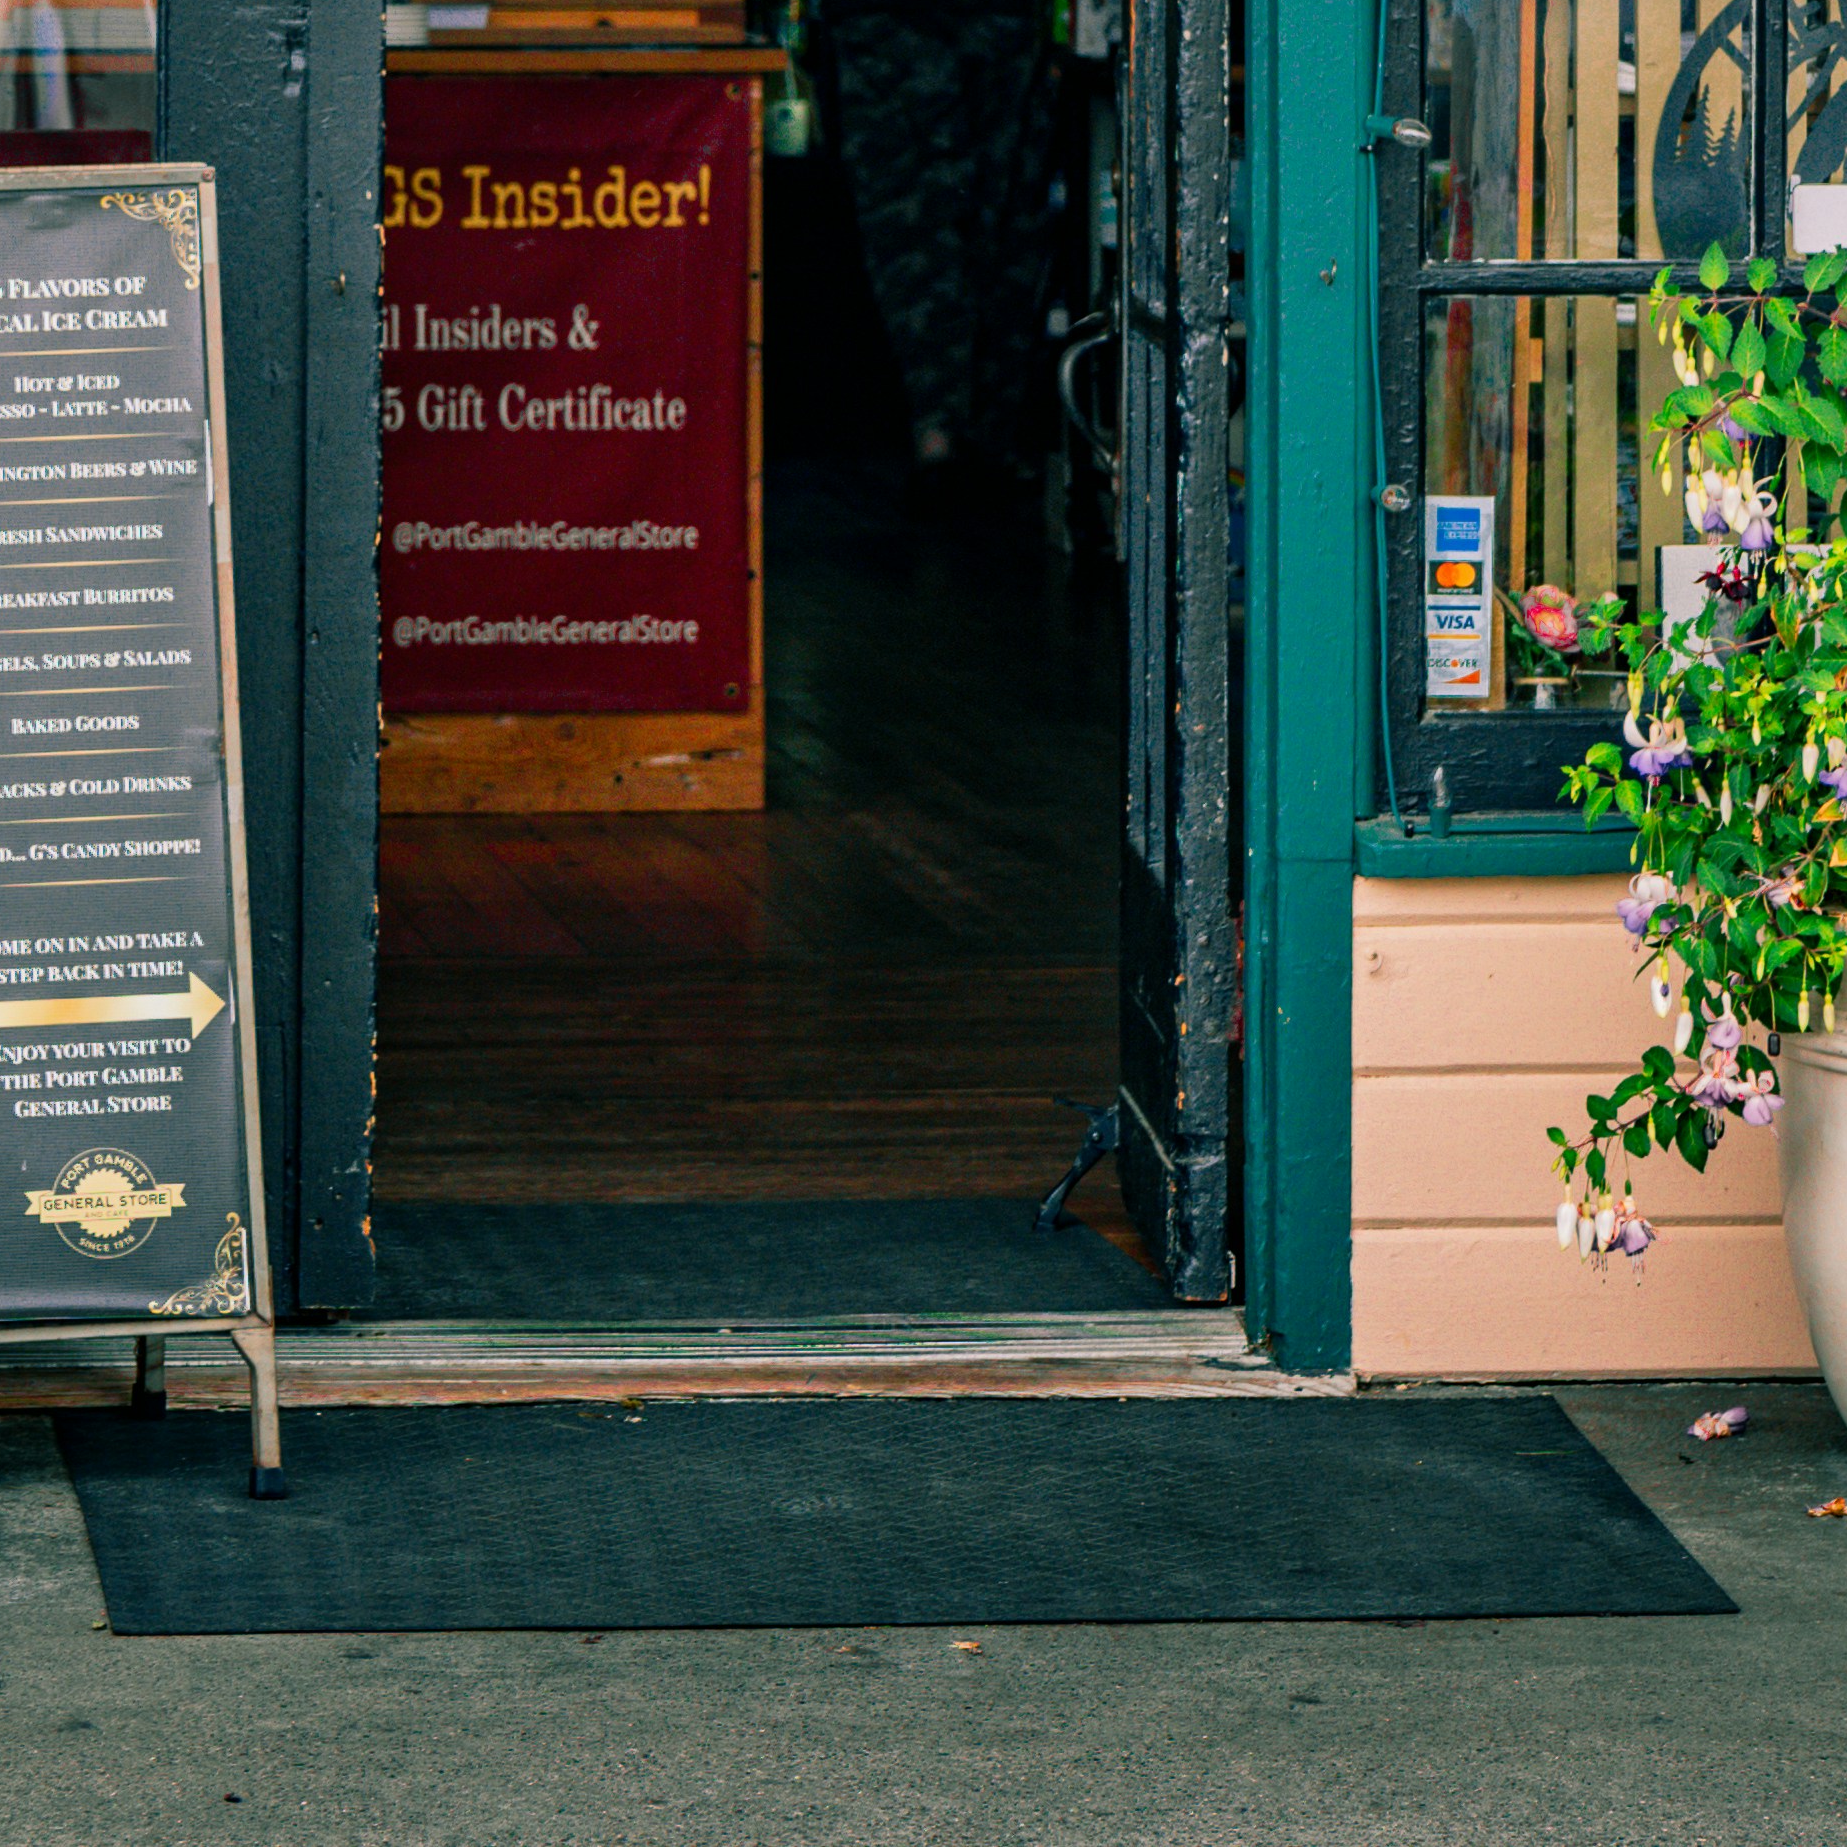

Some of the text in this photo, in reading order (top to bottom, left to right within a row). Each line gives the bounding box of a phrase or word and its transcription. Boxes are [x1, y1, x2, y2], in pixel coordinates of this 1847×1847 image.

[461, 164, 711, 230] Insider!
[8, 278, 109, 299] FLAVORS
[115, 277, 146, 295] OF
[42, 312, 81, 331] ICE
[85, 309, 168, 330] CREAM
[415, 303, 557, 351] Insiders
[568, 304, 599, 351] &
[14, 374, 120, 393] HOT & ICED
[52, 400, 108, 417] LATTE
[124, 397, 192, 414] MOCHA
[418, 383, 486, 431] Gift
[498, 383, 687, 431] Certificate
[70, 462, 126, 479] BEERS
[129, 461, 146, 477] &
[148, 459, 197, 475] WINE
[45, 524, 163, 543] SANDWICHES
[393, 520, 699, 553] @PortGambleGeneralStore
[84, 587, 174, 605] BURRITOS
[393, 615, 699, 646] @PortGambleGeneralStore
[1435, 615, 1475, 629] VISA
[43, 653, 101, 670] SOUPS
[104, 652, 120, 668] &
[124, 650, 191, 667] SALADS
[11, 715, 139, 734] BAKED GOODS
[50, 781, 67, 797] &
[69, 778, 119, 795] COLD
[123, 776, 191, 793] DRINKS
[61, 842, 121, 859] CANDY
[124, 839, 201, 857] SHOPPE!
[35, 938, 63, 953] ON
[69, 937, 89, 952] IN
[93, 935, 134, 951] AND
[136, 933, 187, 949] TAKE
[190, 932, 204, 947] A
[47, 965, 99, 982] BACK
[103, 963, 124, 979] IN
[128, 960, 183, 978] TIME!
[52, 1043, 105, 1059] YOUR
[106, 1040, 158, 1056] VISIT
[162, 1038, 191, 1053] TO
[0, 1067, 183, 1090] THE PORT GAMBLE
[14, 1096, 171, 1118] GENERAL STORE
[60, 1154, 148, 1189] PORT GAMBLE
[44, 1193, 168, 1210] GENERAL STORE
